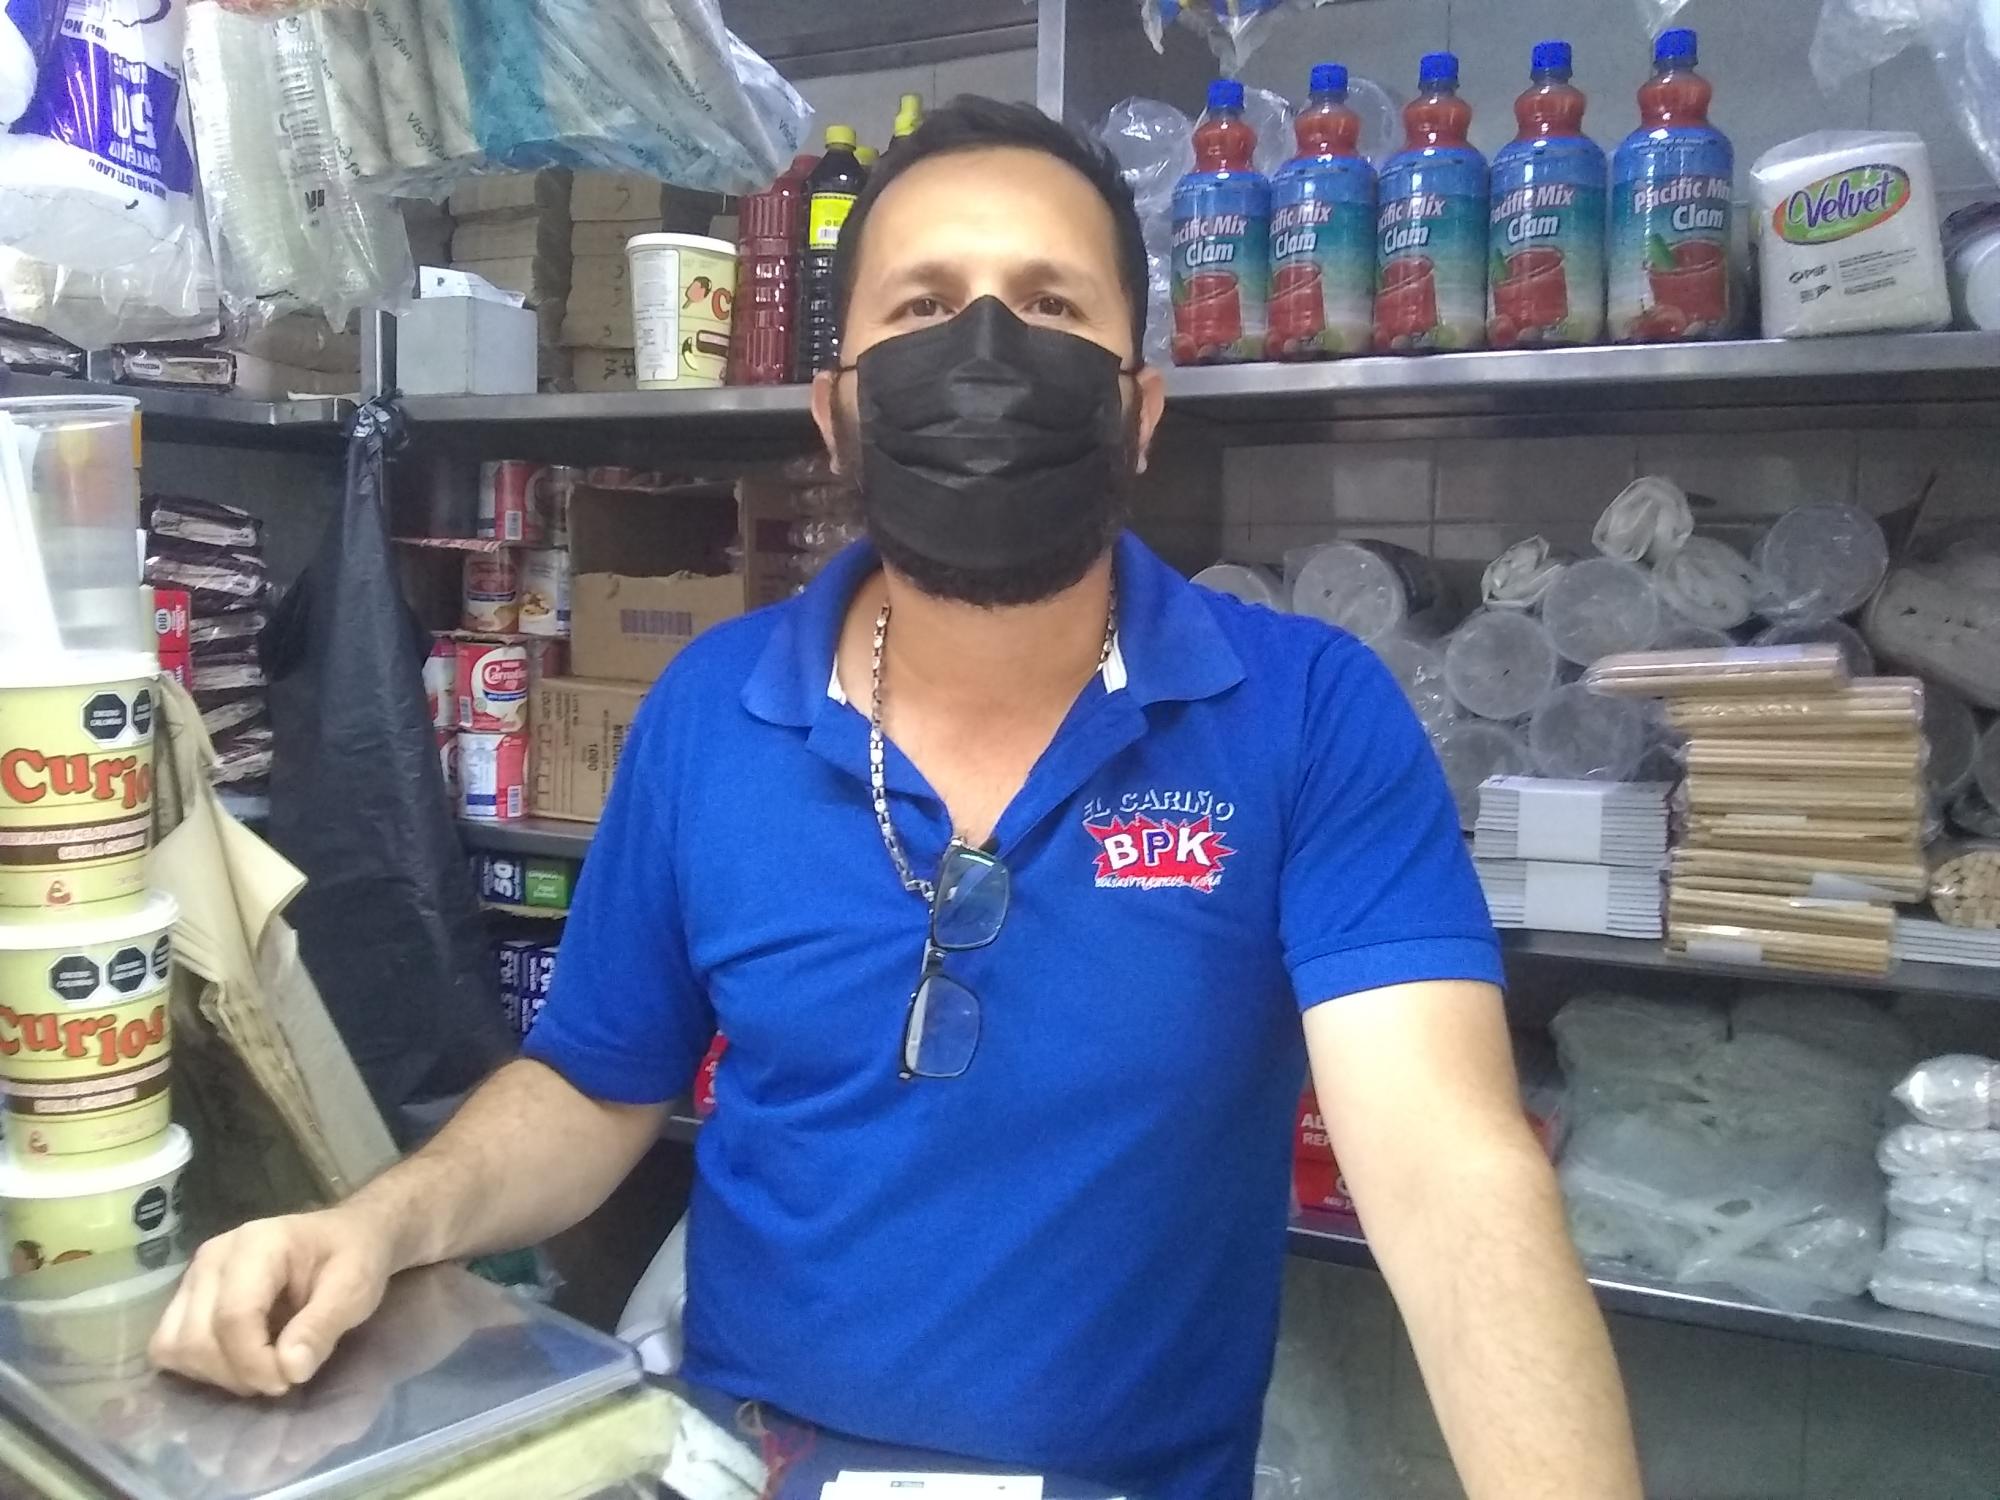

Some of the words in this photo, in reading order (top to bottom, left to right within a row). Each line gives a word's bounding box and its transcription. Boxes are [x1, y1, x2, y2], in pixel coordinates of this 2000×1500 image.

[1536, 183, 1574, 206] Mix
[1634, 177, 1703, 214] Pacific
[1788, 174, 1895, 230] Velvet
[1213, 215, 1247, 237] Mix
[1507, 214, 1559, 244] Clam
[1672, 203, 1723, 231] Clam
[1186, 241, 1234, 267] Clam
[1275, 231, 1317, 260] Clam
[1384, 225, 1430, 254] Clam
[1103, 827, 1214, 871] BPK
